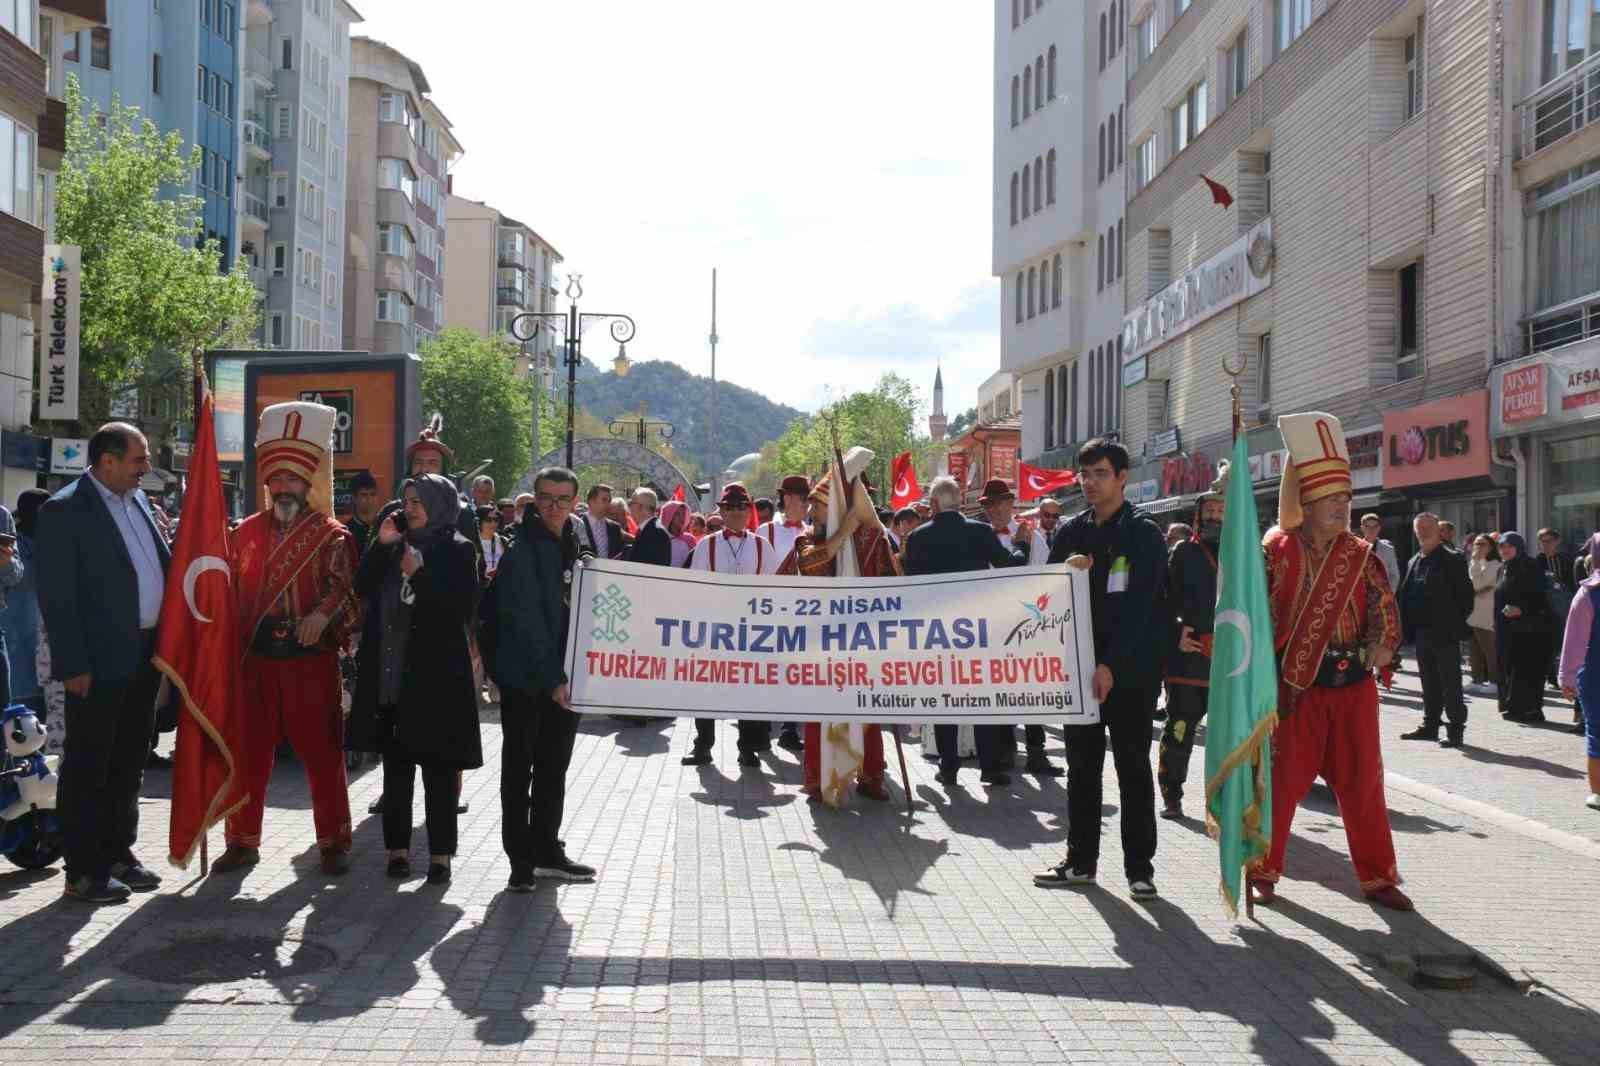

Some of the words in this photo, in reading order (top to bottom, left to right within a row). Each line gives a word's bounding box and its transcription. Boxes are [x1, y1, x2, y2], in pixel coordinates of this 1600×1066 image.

[49, 277, 67, 359] Telekom
[48, 365, 65, 408] Türk
[747, 598, 773, 615] 15
[795, 599, 822, 616] 22
[829, 595, 902, 615] NİSAN
[655, 617, 807, 653] TURİZM
[821, 617, 988, 651] HAFTASI
[1003, 608, 1072, 648] Türkiye
[586, 649, 667, 681] TURİZM
[674, 653, 778, 686] HİZMETLE
[785, 654, 875, 692] GELİŞİR,
[881, 654, 944, 686] SEVGİ
[951, 654, 987, 686] İLE
[989, 652, 1070, 685] BÜYÜR.
[857, 690, 867, 708] İl
[872, 693, 917, 708] Kültür
[921, 697, 937, 708] ve
[941, 692, 991, 708] Turizm
[995, 691, 1073, 710] Müdürlüğü
